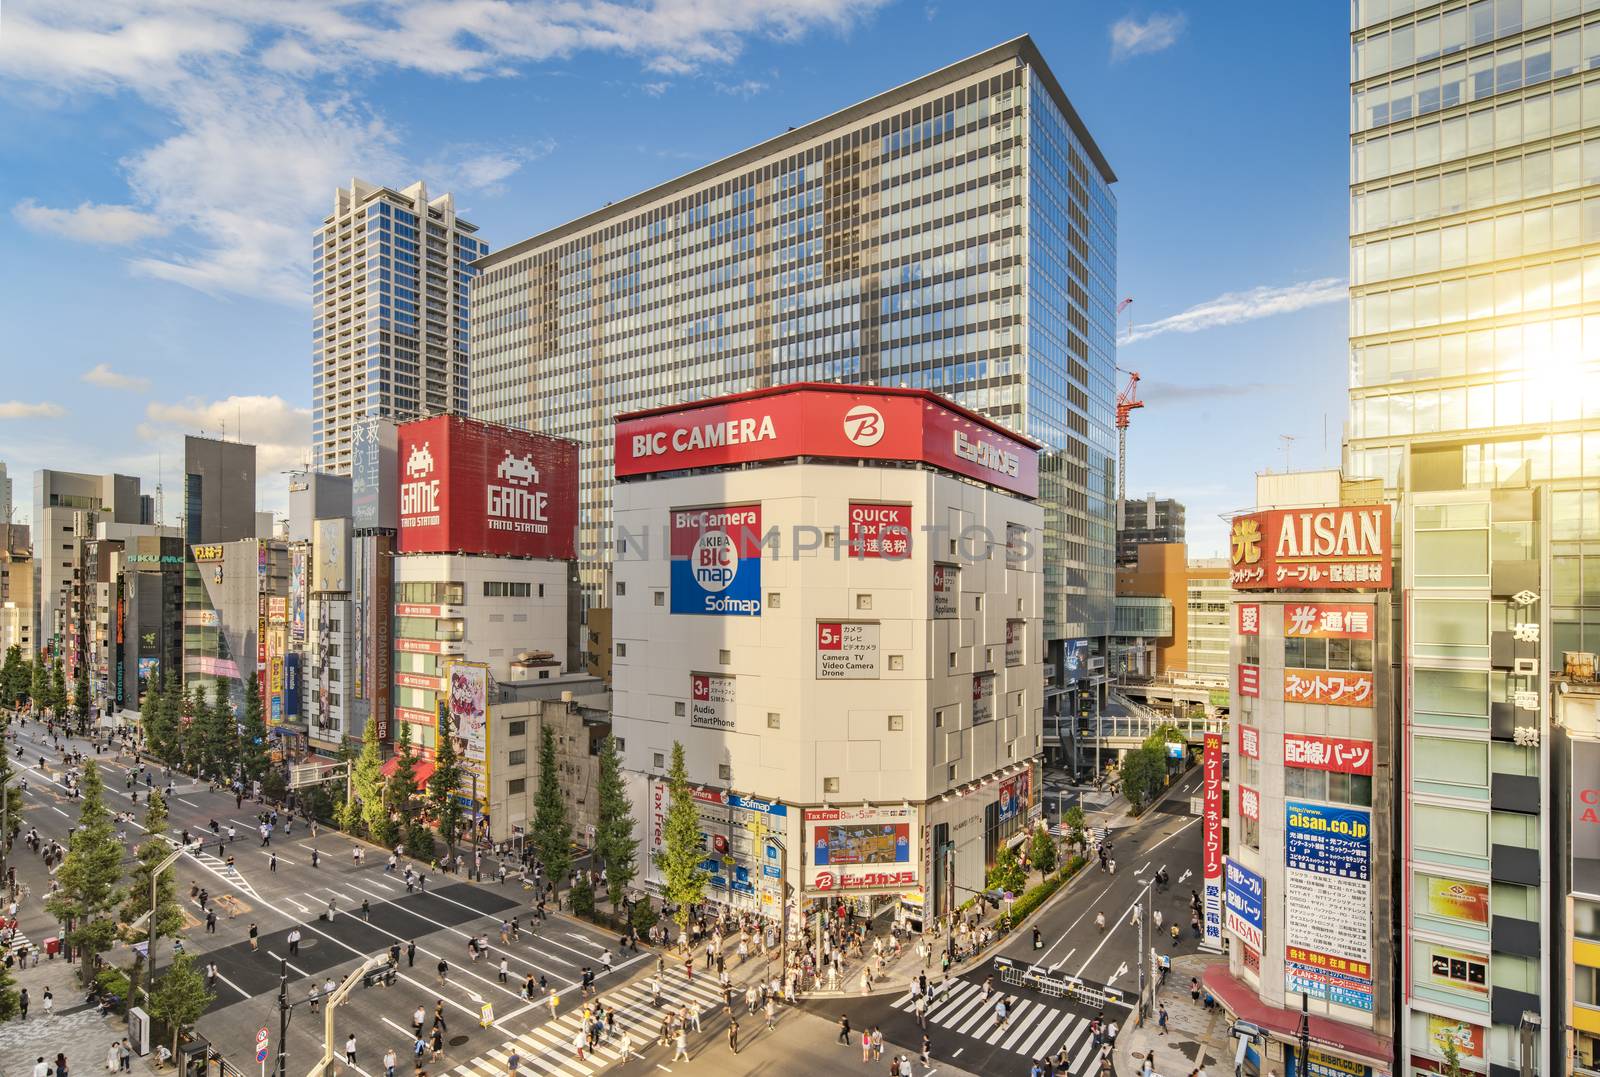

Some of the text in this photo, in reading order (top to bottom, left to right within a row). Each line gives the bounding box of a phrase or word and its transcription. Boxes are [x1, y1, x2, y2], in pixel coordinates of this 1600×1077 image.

[632, 414, 777, 457] BIC CAMERA
[953, 428, 1020, 478] ビックカメラ
[401, 480, 440, 514] GAME
[487, 485, 548, 521] GAME
[401, 515, 440, 528] TAITO STATION
[852, 509, 899, 523] QUICK
[488, 519, 548, 534] TAITO STATION
[852, 523, 908, 536] Tax Free
[1275, 509, 1383, 557] AISAN
[699, 535, 730, 548] AKIBA
[853, 539, 907, 553] 快速免税
[700, 547, 731, 567] BIC
[697, 568, 733, 587] map
[935, 571, 943, 586] 6F
[705, 595, 760, 615] Sofmap
[935, 596, 949, 605] Home
[935, 604, 957, 615] Appliance
[821, 628, 840, 644] 5F
[694, 680, 709, 696] 3F
[1285, 673, 1371, 701] ネットワーク
[693, 704, 715, 715] Audio
[693, 714, 735, 728] SmartPhone
[1284, 738, 1370, 768] 配線パーツ
[740, 796, 771, 812] Sofmap
[655, 784, 664, 846] Tax Free
[807, 812, 820, 820] Tax
[1289, 813, 1367, 838] aisan.co.jp
[840, 872, 913, 887] ビックカメラ
[1206, 885, 1220, 938] 愛三電機
[1228, 914, 1261, 948] AISAN
